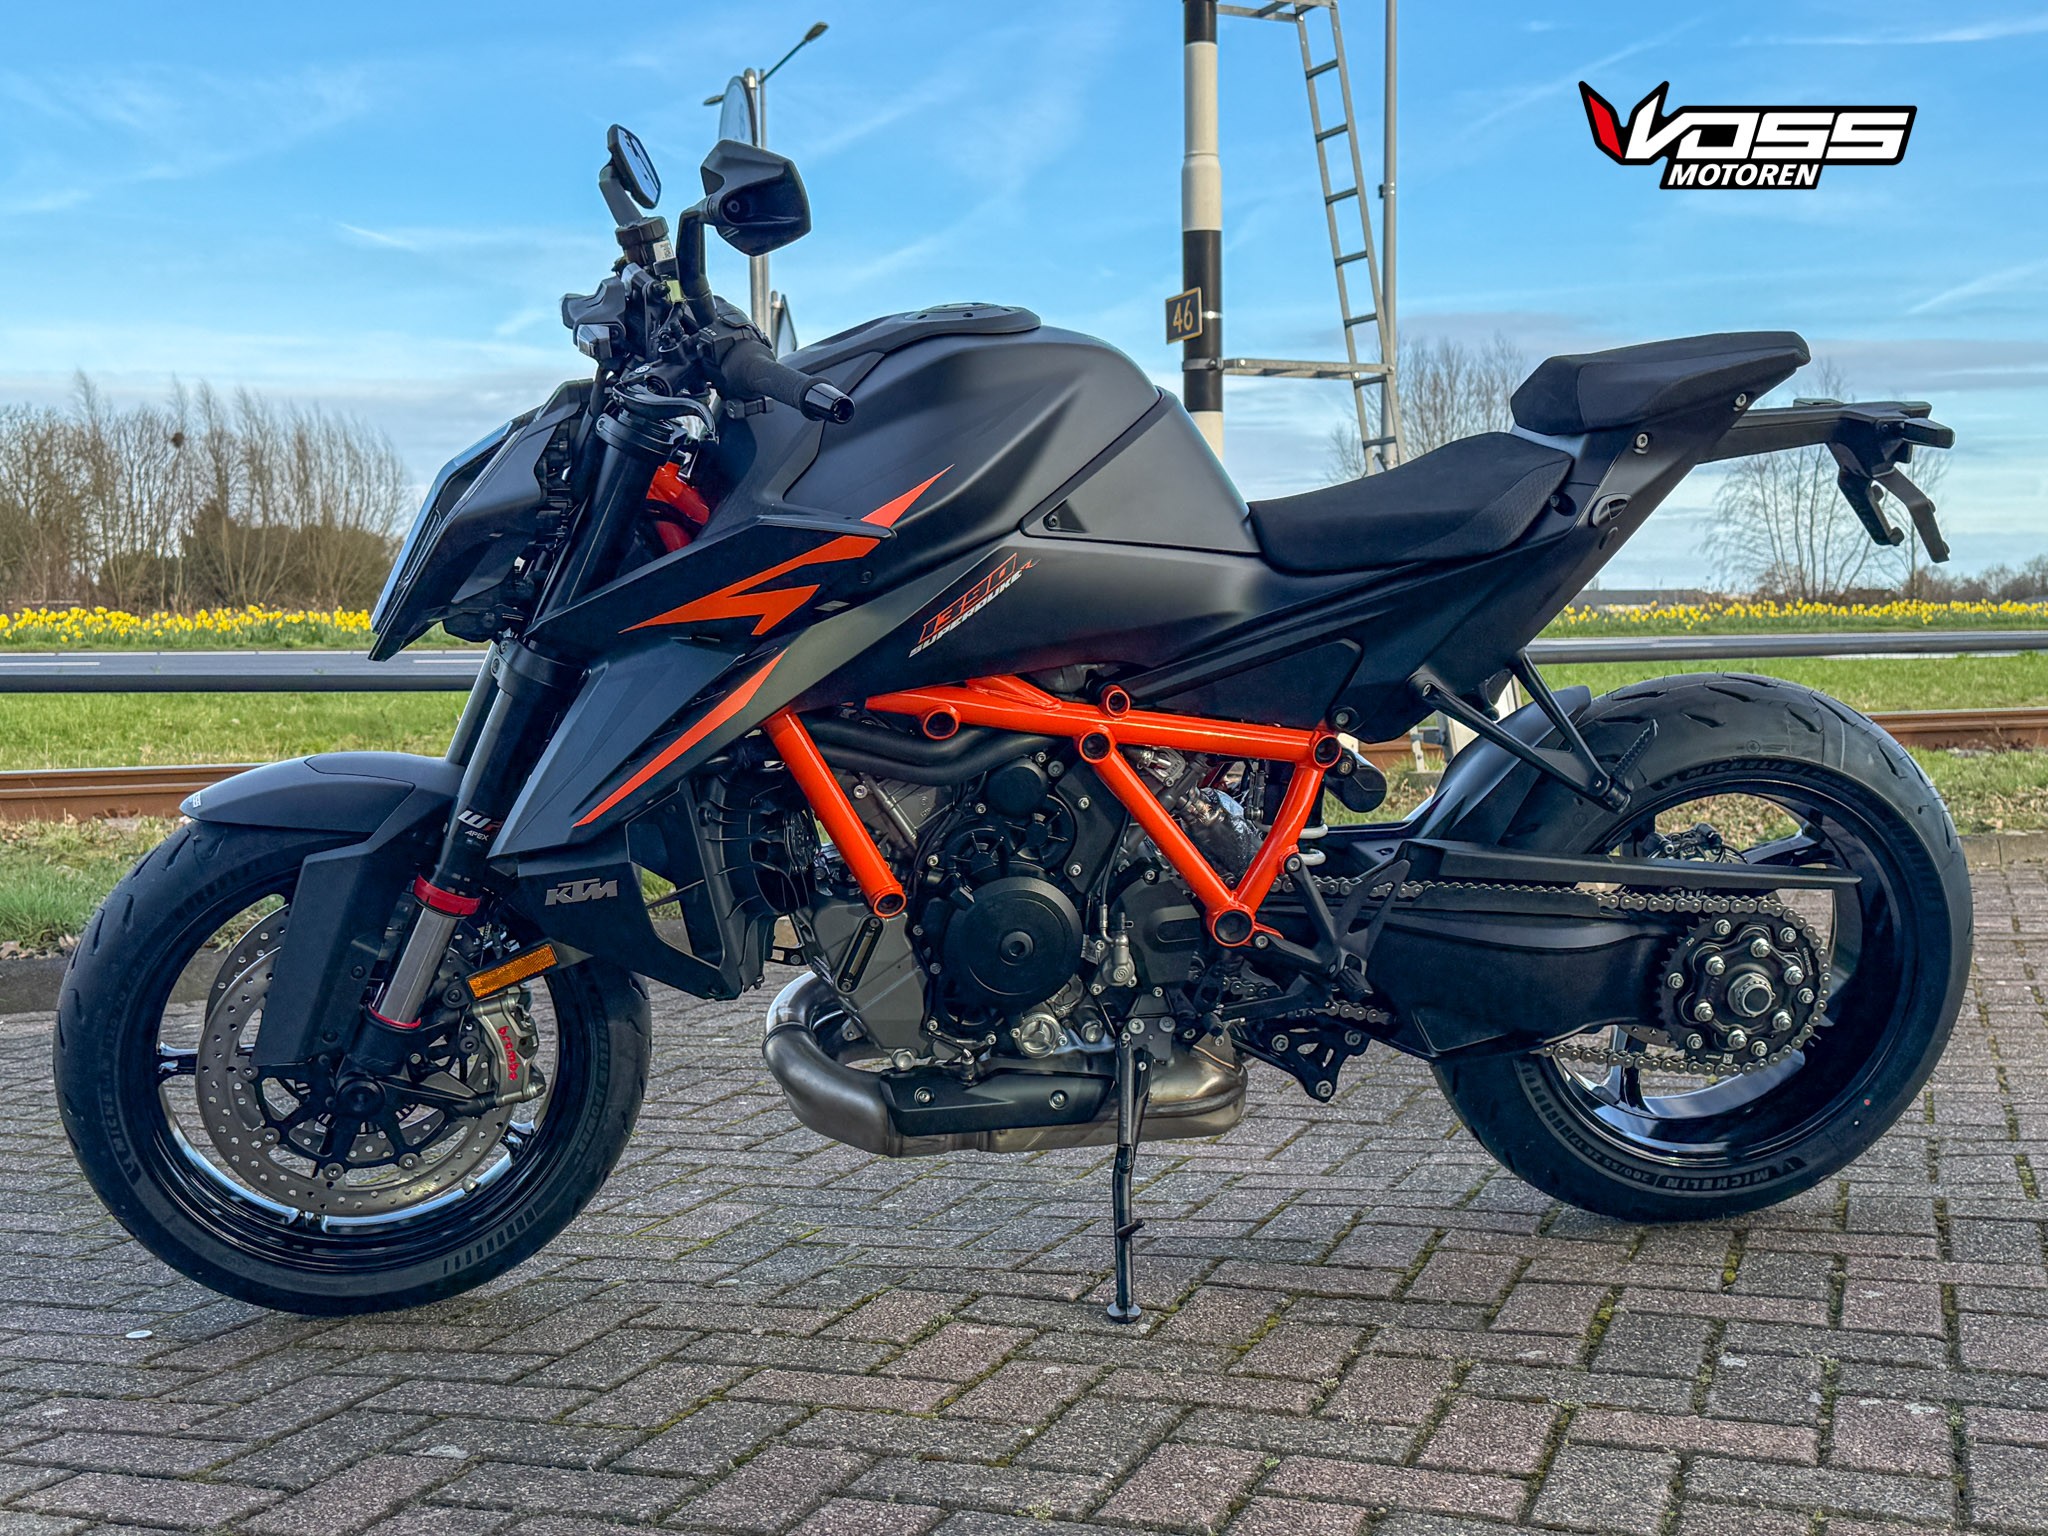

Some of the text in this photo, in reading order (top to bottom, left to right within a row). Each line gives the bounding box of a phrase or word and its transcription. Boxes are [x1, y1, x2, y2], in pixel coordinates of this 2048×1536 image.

[1172, 299, 1194, 333] 46
[464, 830, 490, 842] APEX
[544, 877, 619, 906] KTM
[1664, 1167, 1771, 1190] MICHELIN
